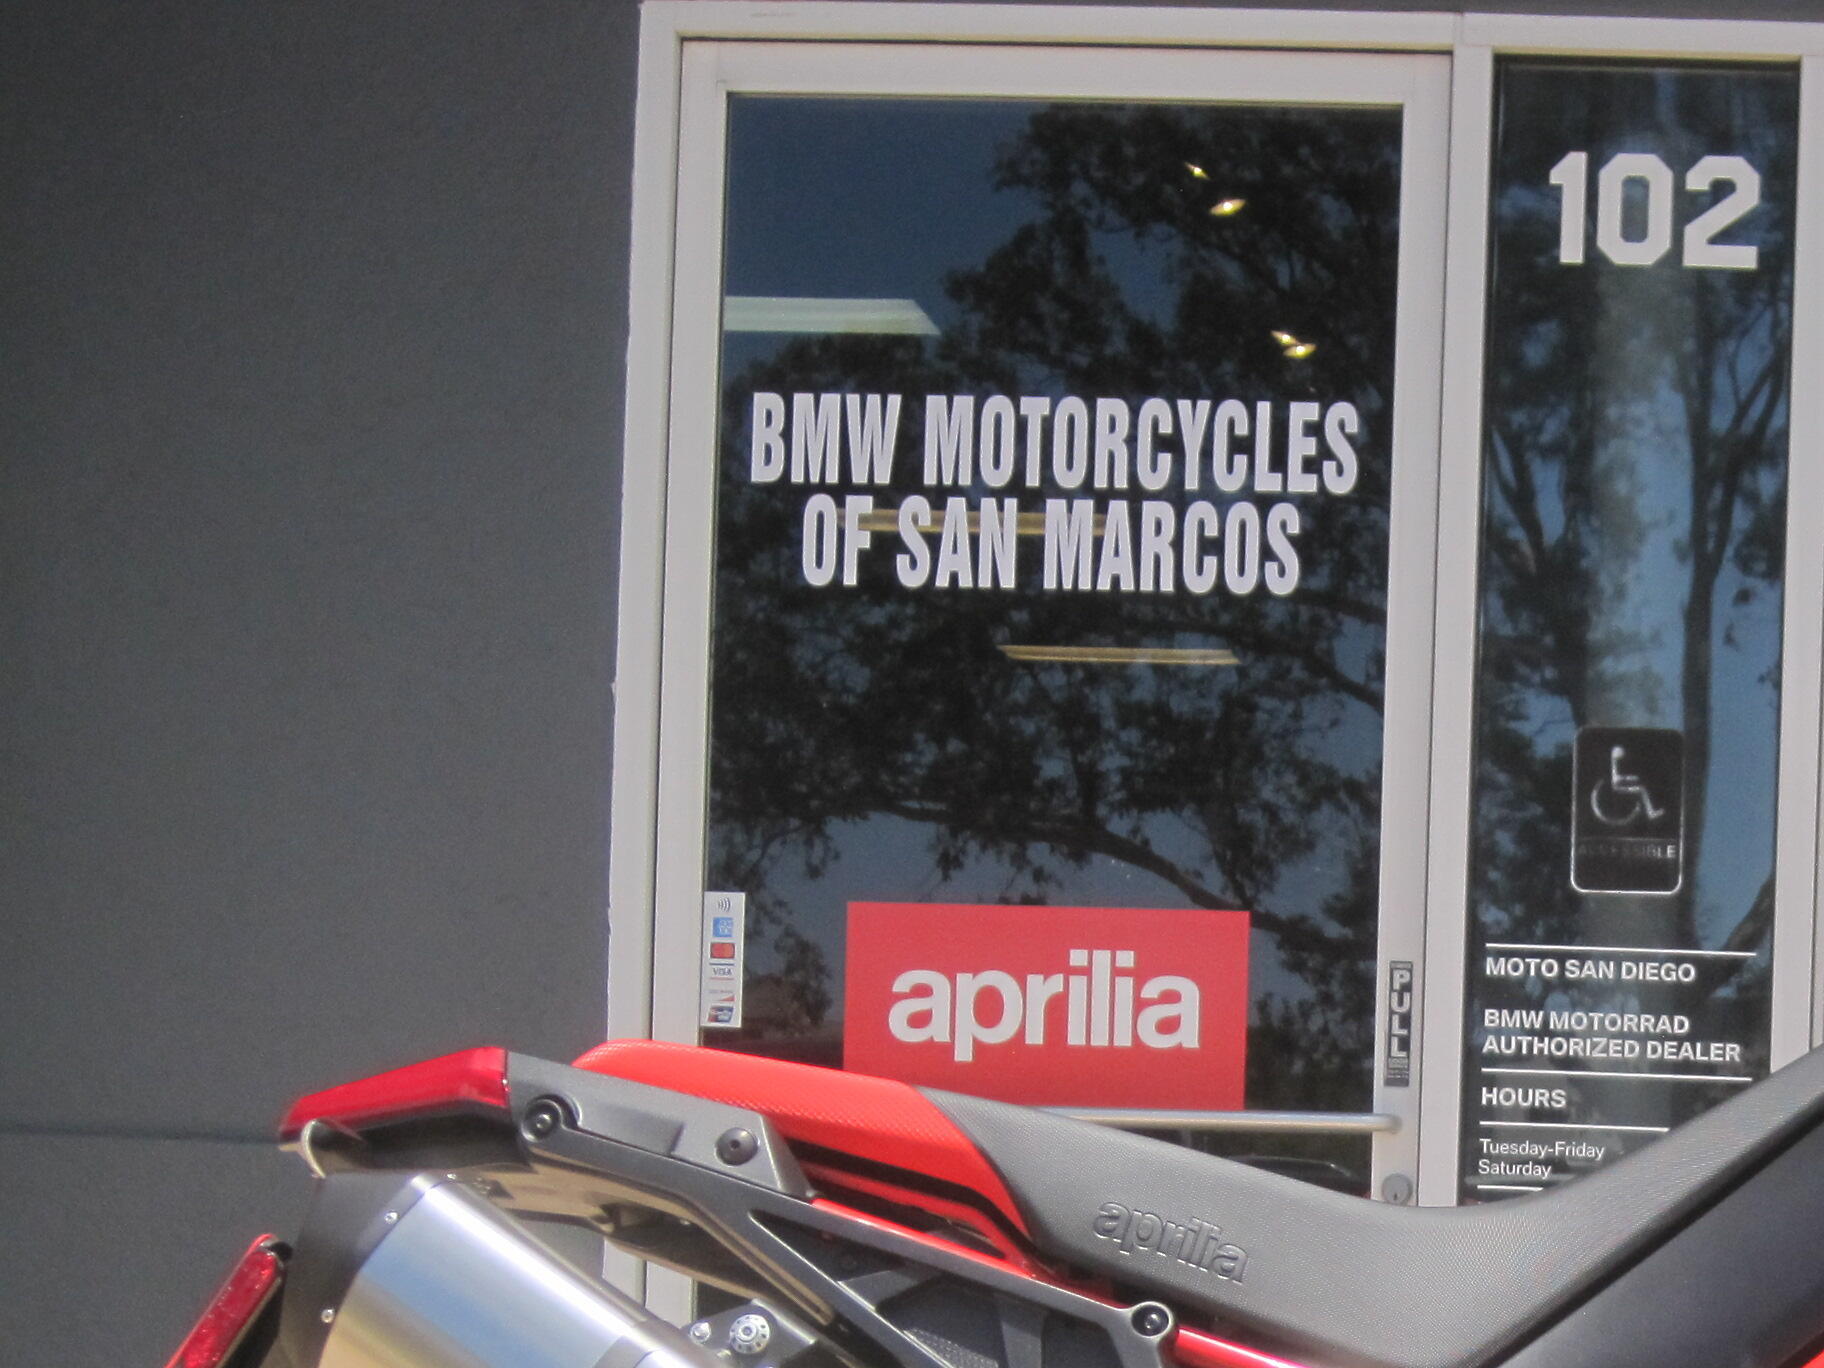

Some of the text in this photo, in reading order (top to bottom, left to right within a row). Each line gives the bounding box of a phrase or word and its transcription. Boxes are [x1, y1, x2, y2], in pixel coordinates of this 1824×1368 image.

[1550, 151, 1761, 270] 102
[750, 392, 1359, 494] BMW MOTORCYCLES
[801, 493, 1301, 596] OF SAN MARCOS
[1485, 957, 1697, 982] MOTO SAN DIEGO
[887, 949, 1201, 1062] aprilia
[1390, 968, 1411, 1058] PULL
[1483, 1008, 1691, 1034] BMW MOTORRAD
[1481, 1035, 1742, 1062] AUTHORIZED DEALER
[1480, 1086, 1568, 1109] HOURS
[1477, 1158, 1552, 1180] Saturday
[1478, 1137, 1606, 1161] Tuesday-Friday
[1092, 1201, 1249, 1286] aprilia
